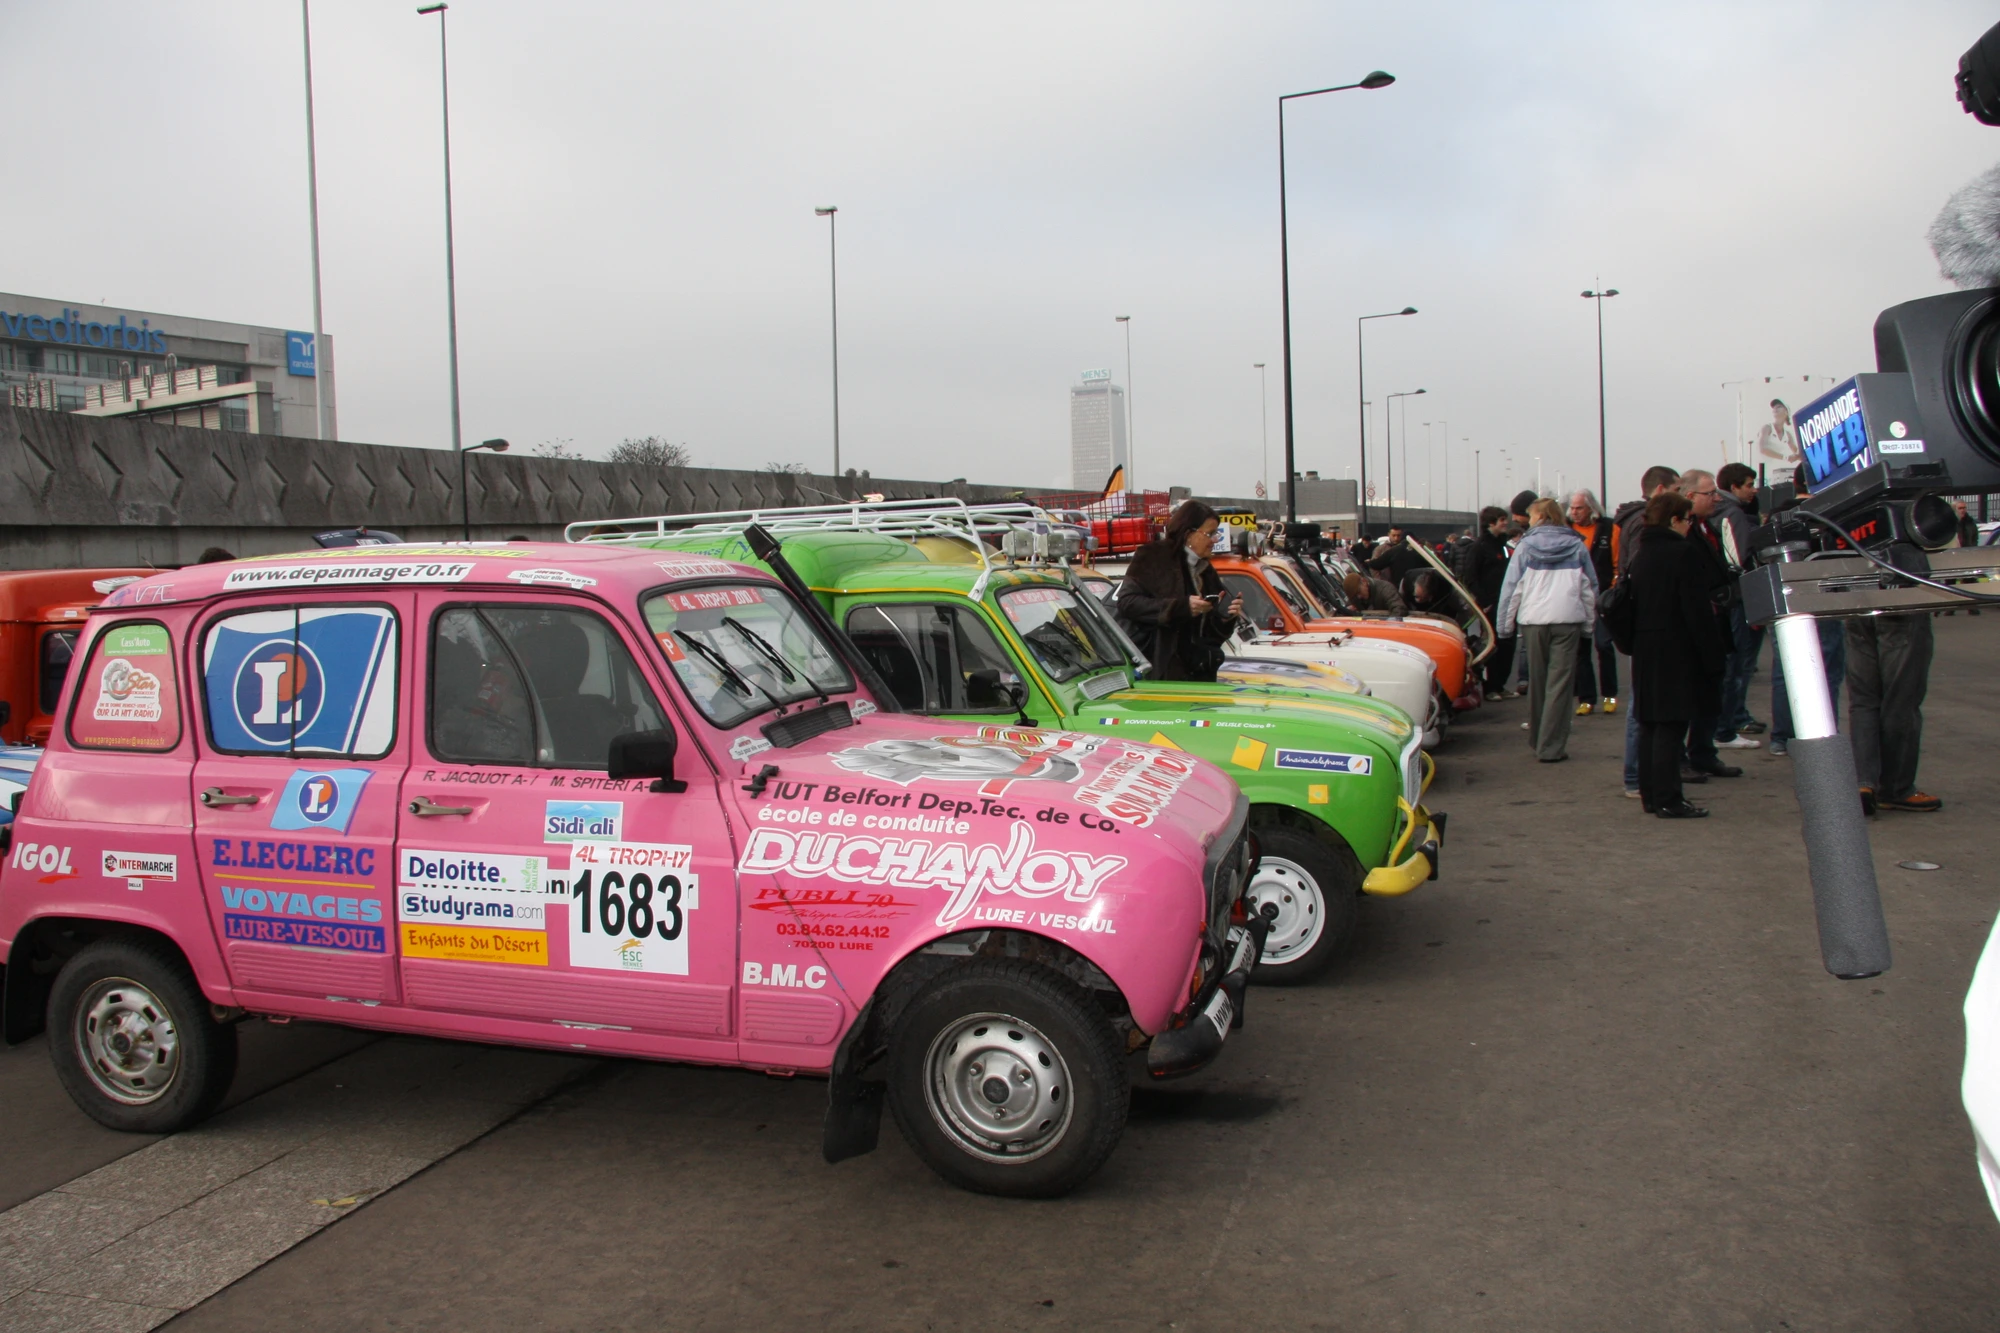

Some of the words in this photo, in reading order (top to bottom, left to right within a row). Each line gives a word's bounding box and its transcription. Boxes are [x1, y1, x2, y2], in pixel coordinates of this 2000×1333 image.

[0, 308, 168, 353] vediorbis
[1798, 388, 1860, 449] NORMANDIE
[1804, 413, 1867, 483] WEB
[1851, 447, 1871, 472] TV
[231, 564, 469, 583] www.depannage70.fr
[680, 595, 697, 610] 4L
[694, 592, 732, 608] TROPHY
[662, 638, 674, 655] P
[96, 708, 110, 717] SUR
[111, 709, 120, 717] LA
[121, 709, 132, 718] HIT
[134, 709, 155, 718] RADIO
[423, 770, 436, 782] R.
[441, 771, 508, 785] JACQUOT
[550, 775, 566, 788] M.
[570, 777, 629, 791] SPITERI
[758, 803, 822, 825] école
[828, 808, 857, 827] de
[862, 813, 970, 835] conduite
[773, 782, 819, 801] IUT
[823, 785, 911, 809] Belfort
[1036, 807, 1070, 825] de
[1079, 812, 1121, 834] Co.
[547, 816, 584, 834] Sidi
[589, 817, 615, 835] ali
[575, 845, 600, 864] 4L
[609, 847, 691, 869] TROPHY
[738, 820, 1128, 928] DUCHANOY
[221, 886, 383, 923] VOYAGES
[573, 869, 683, 941] 1683
[753, 888, 861, 901] PUBLI
[866, 893, 895, 908] 70
[776, 923, 890, 938] 03.84.62.44.12
[973, 907, 1024, 924] LURE
[1040, 911, 1117, 935] VESOUL
[227, 918, 382, 950] LURE-VESOUL
[408, 929, 466, 950] Enfants
[470, 935, 490, 950] du
[493, 935, 540, 953] Désert
[622, 950, 643, 962] ESC
[839, 942, 874, 951] LURE
[742, 961, 827, 989] B.M.C
